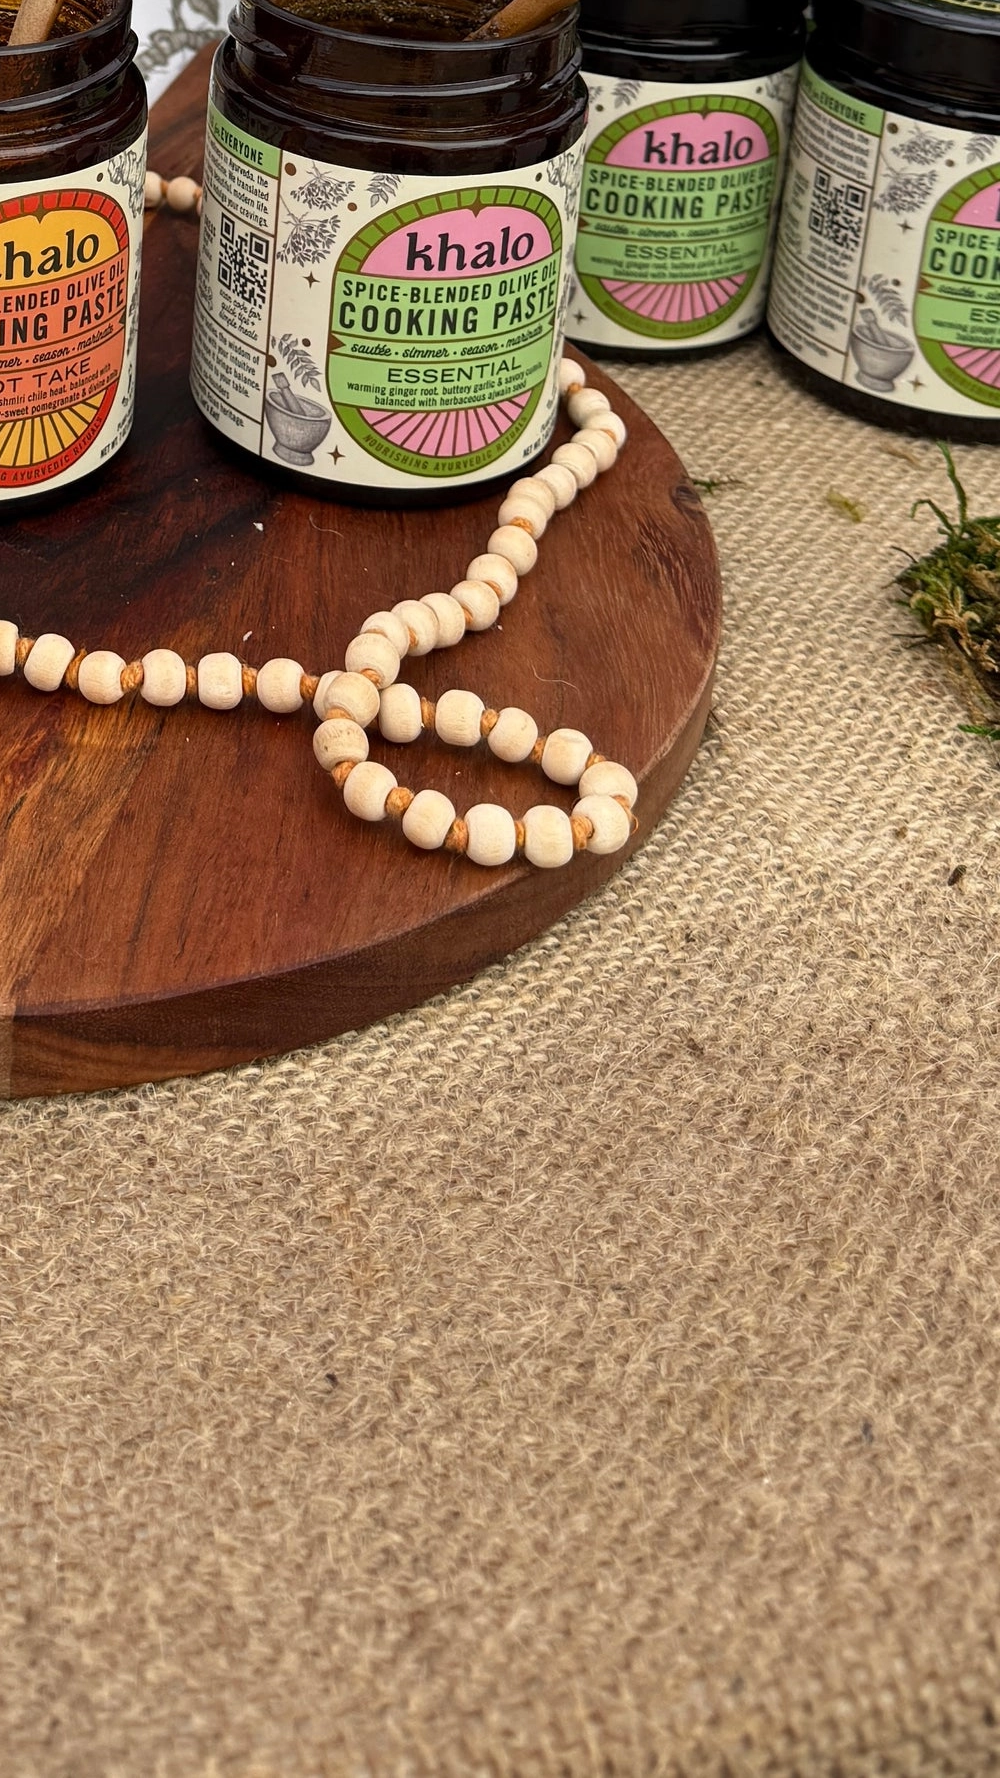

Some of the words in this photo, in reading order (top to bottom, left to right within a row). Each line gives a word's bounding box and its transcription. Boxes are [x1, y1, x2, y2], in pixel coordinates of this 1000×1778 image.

[220, 125, 264, 166] EVERYONE
[643, 130, 753, 165] khalo
[588, 168, 716, 192] SPICE-BLENDED
[585, 187, 704, 220] COOKING
[715, 180, 773, 217] PASTE
[406, 225, 534, 272] khalo
[624, 241, 739, 260] ESSENTIAL
[67, 270, 106, 302] OLIVE
[109, 257, 125, 282] OIL
[343, 279, 493, 304] SPICE-BLENDED
[498, 270, 538, 298] OLIVE
[541, 259, 557, 282] OIL
[62, 277, 125, 335] PASTE
[338, 301, 478, 336] COOKING
[492, 279, 556, 331] PASTE
[32, 348, 70, 365] season
[402, 342, 449, 359] simmer
[32, 357, 91, 389] TAKE
[387, 356, 522, 383] ESSENTIAL
[28, 389, 47, 403] chile
[31, 392, 80, 416] pomegranate
[346, 381, 387, 396] warming
[389, 385, 418, 398] ginger
[442, 384, 472, 397] buttery
[374, 395, 416, 408] balanced
[418, 395, 438, 408] with
[440, 390, 486, 408] herbaceous
[363, 433, 428, 471] NOURISHING
[12, 454, 70, 482] AYURVEDIC
